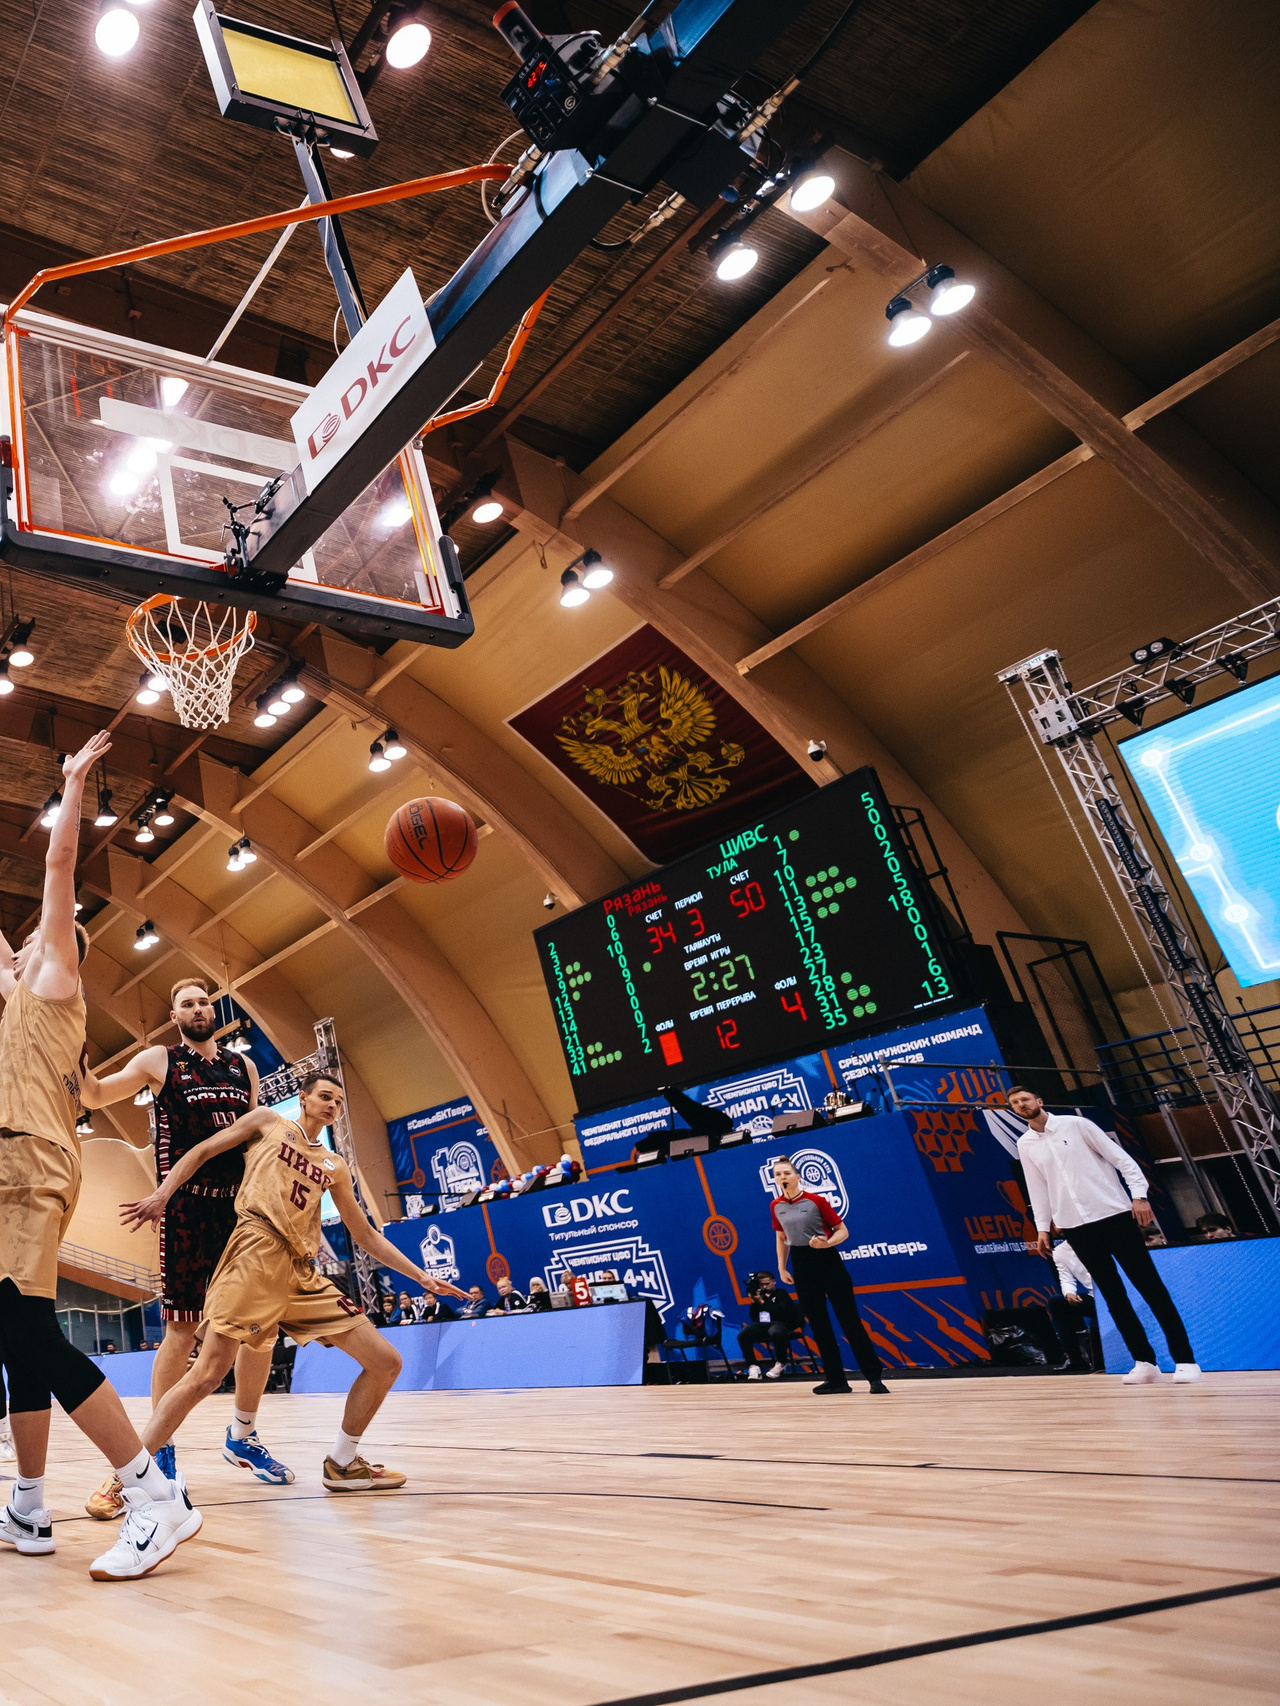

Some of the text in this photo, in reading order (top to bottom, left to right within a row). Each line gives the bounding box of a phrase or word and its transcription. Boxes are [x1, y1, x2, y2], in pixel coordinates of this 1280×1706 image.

[340, 315, 416, 421] DKC
[860, 791, 874, 809] 5
[867, 808, 880, 824] 0
[874, 824, 887, 840] 0
[720, 824, 768, 859] ЦИВС
[773, 835, 782, 849] 1
[879, 840, 895, 858] 2
[776, 849, 787, 866] 7
[887, 856, 900, 873] 0
[706, 858, 738, 879] ТУЛА
[729, 869, 750, 885] СЧЕТ
[892, 872, 907, 890] 5
[603, 881, 662, 915] Рязань
[674, 891, 703, 910] ПЕРИОД
[729, 881, 765, 918] 50
[606, 915, 616, 928] 0
[645, 909, 663, 923] СЧЕТ
[687, 908, 705, 936] 3
[907, 906, 920, 923] 0
[610, 928, 619, 941] 6
[646, 922, 677, 954] 34
[914, 924, 927, 941] 0
[548, 942, 557, 956] 2
[684, 945, 731, 971] ВРЕМЯ ИГРЫ
[921, 941, 933, 958] 1
[551, 955, 560, 968] 3
[618, 955, 627, 968] 0
[928, 958, 942, 976] 6
[554, 968, 563, 981] 5
[622, 968, 631, 982] 9
[690, 954, 755, 1001] 2:27
[774, 975, 797, 990] ФОЛЫ
[558, 981, 567, 994] 9
[626, 982, 635, 996] 0
[630, 996, 639, 1009] 0
[689, 990, 757, 1021] ВРЕМЯ ПЕРЕРЫВА
[780, 991, 807, 1021] 4
[634, 1010, 643, 1024] 0
[655, 1019, 674, 1032] ФОЛЫ
[637, 1024, 646, 1038] 7
[716, 1019, 740, 1049] 12
[641, 1038, 652, 1053] 2
[838, 1024, 983, 1070] СРЕДИ МУЖСКИХ КОМАНД
[842, 1065, 877, 1081] СЕЗОН
[723, 1080, 778, 1100] ЧЕМПИОНАТ ЦФО
[407, 1104, 473, 1131] #СемьяБКТверь
[722, 1098, 768, 1121] ИНАЛ
[212, 1111, 237, 1128] 41
[581, 1119, 622, 1137] ЧЕМПИОНАТ
[584, 1119, 668, 1147] ФЕДЕРАЛЬНОГО ОКРУГА
[277, 1142, 332, 1193] ЦИВС
[289, 1179, 311, 1211] 15
[570, 1189, 634, 1222] DKC
[549, 1219, 639, 1241] Титульный спонсор
[964, 1215, 1022, 1243] ЦЕЛЬ
[568, 1250, 631, 1267] ЧЕМПИОНАТ ЦФО
[574, 1282, 588, 1300] 5
